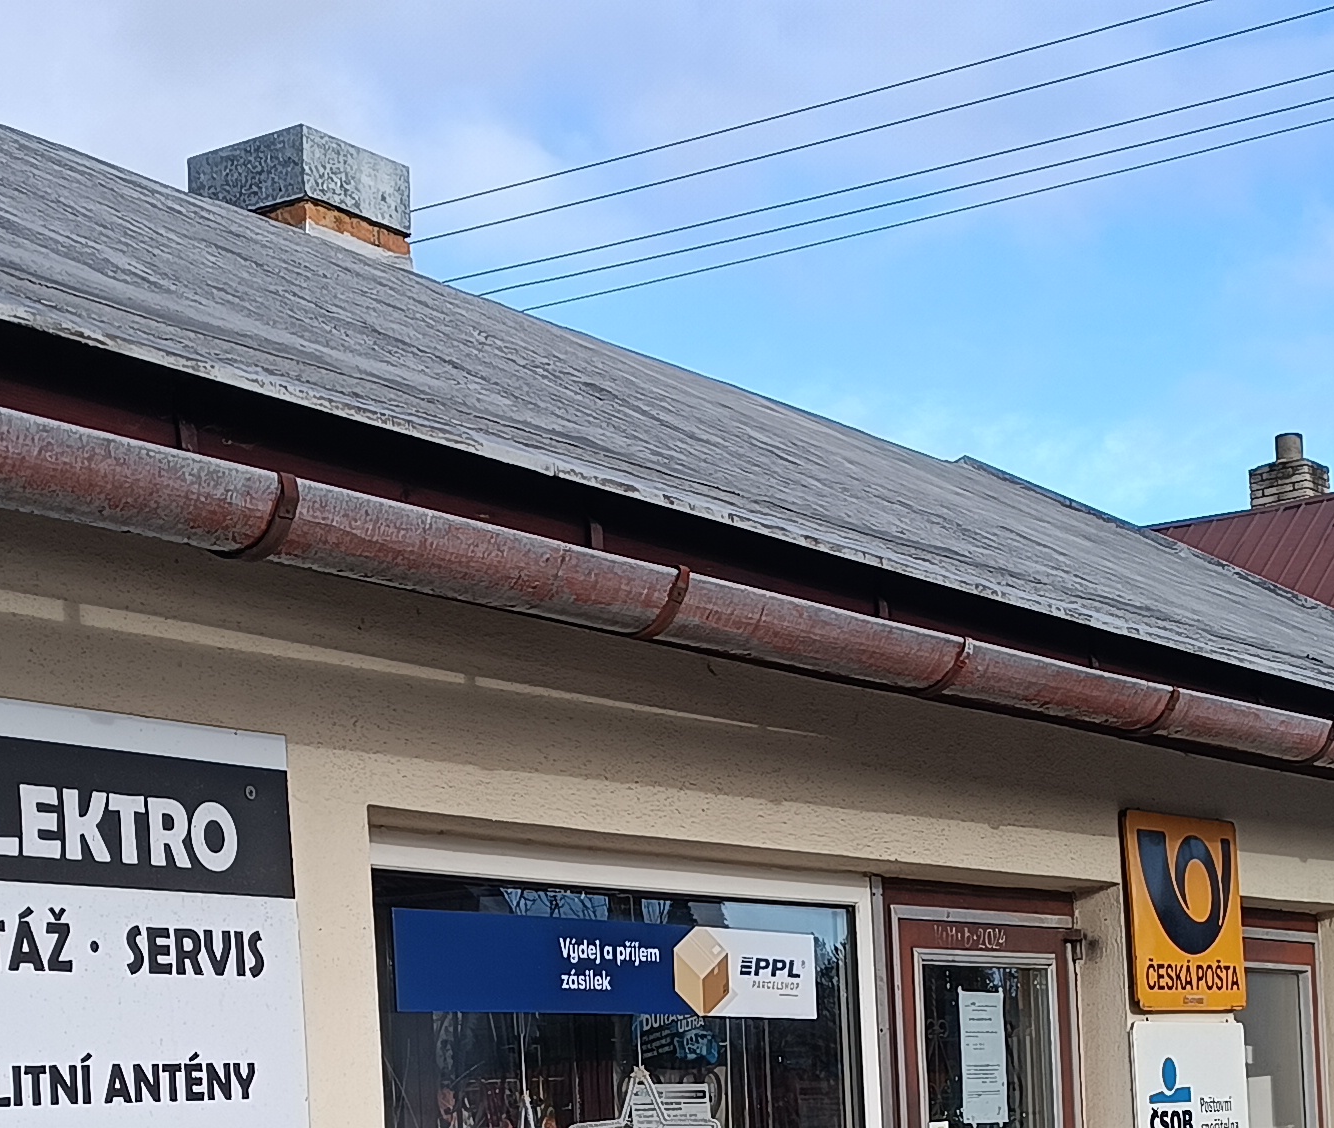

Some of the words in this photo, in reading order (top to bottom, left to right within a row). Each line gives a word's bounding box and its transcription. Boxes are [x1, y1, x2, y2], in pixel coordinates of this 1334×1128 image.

[126, 925, 265, 979] SERVIS
[559, 938, 601, 964] Výdej
[604, 946, 613, 960] a
[616, 941, 660, 967] příjem
[754, 957, 801, 979] PPL
[1146, 958, 1193, 991] ČESKÁ
[1196, 959, 1240, 991] POŠTA
[561, 969, 612, 991] zásilek
[752, 981, 800, 991] PARCELSHOP
[677, 1016, 704, 1033] ULTRA
[105, 1051, 256, 1105] ANTÉNY
[1200, 1096, 1231, 1113] Poštovní
